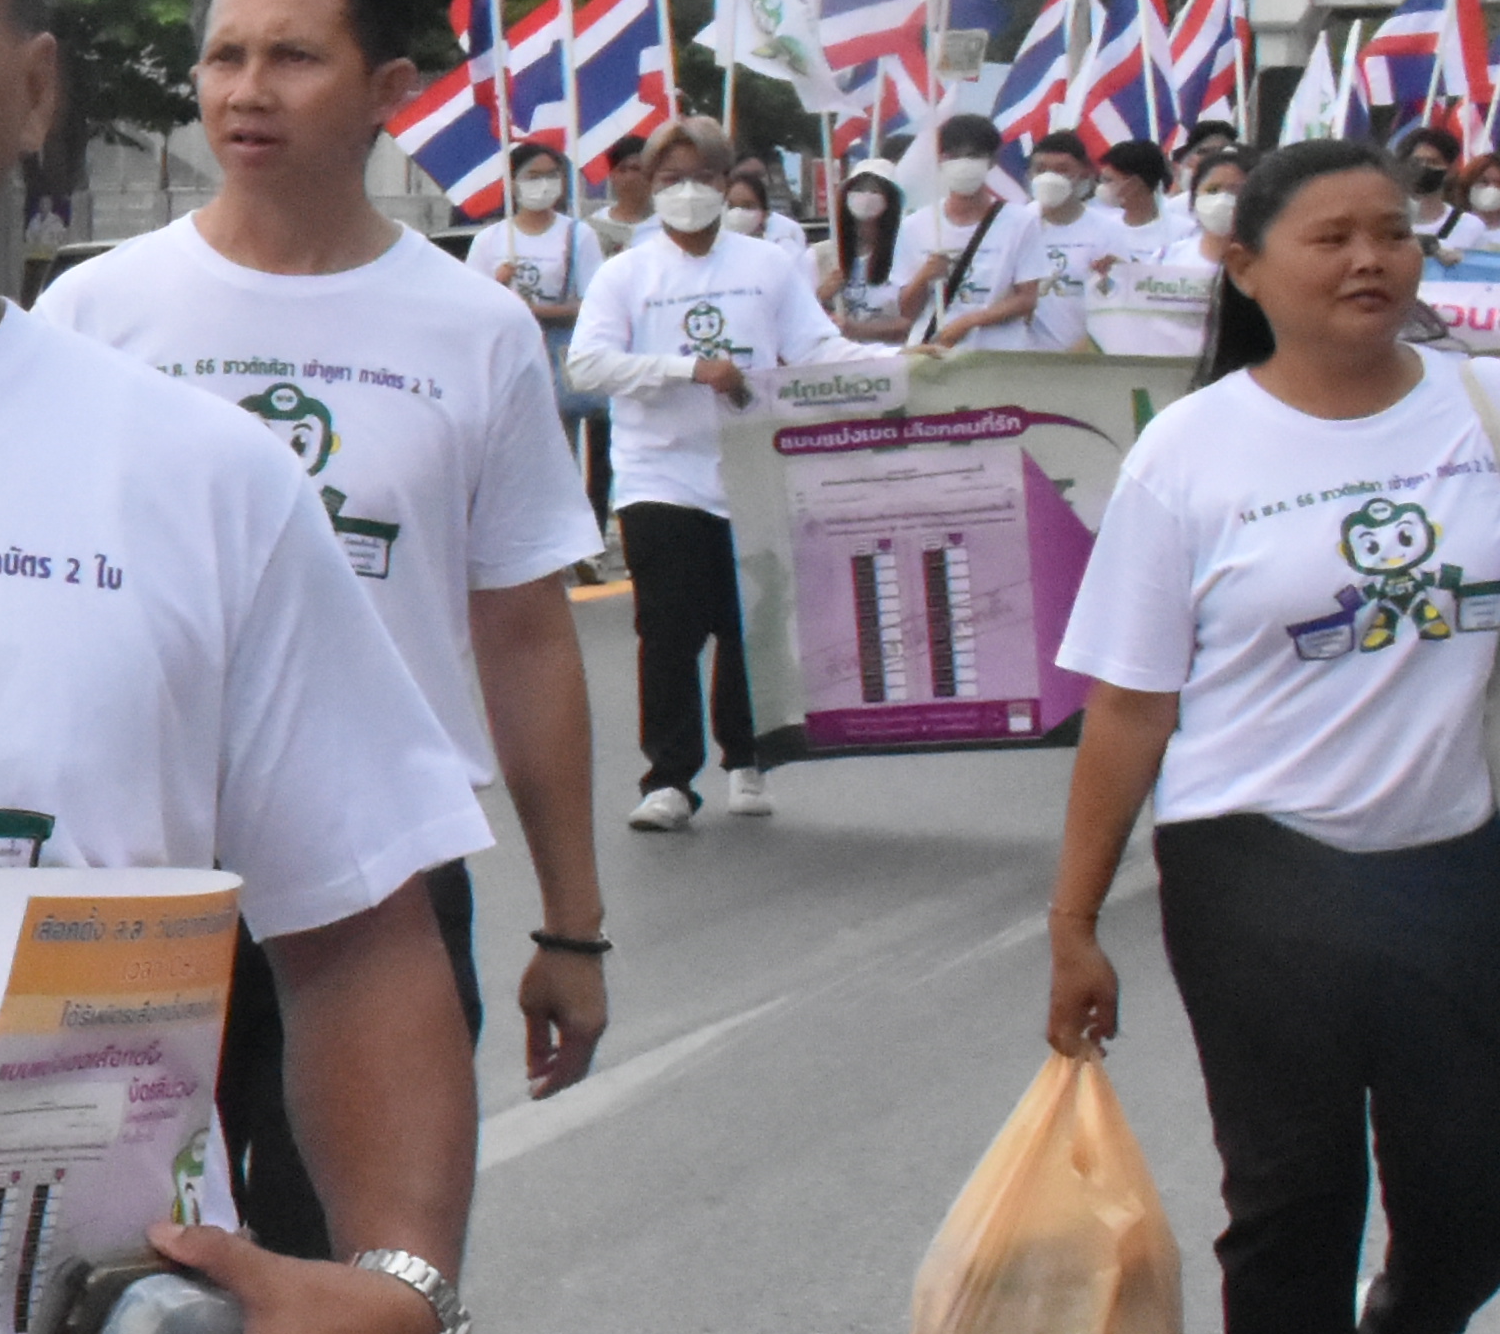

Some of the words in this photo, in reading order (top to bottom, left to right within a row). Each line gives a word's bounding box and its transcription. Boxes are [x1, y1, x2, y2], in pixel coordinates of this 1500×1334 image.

[195, 358, 216, 376] 66
[411, 378, 421, 393] 2
[64, 557, 81, 584] 2
[95, 553, 123, 590] ใบ
